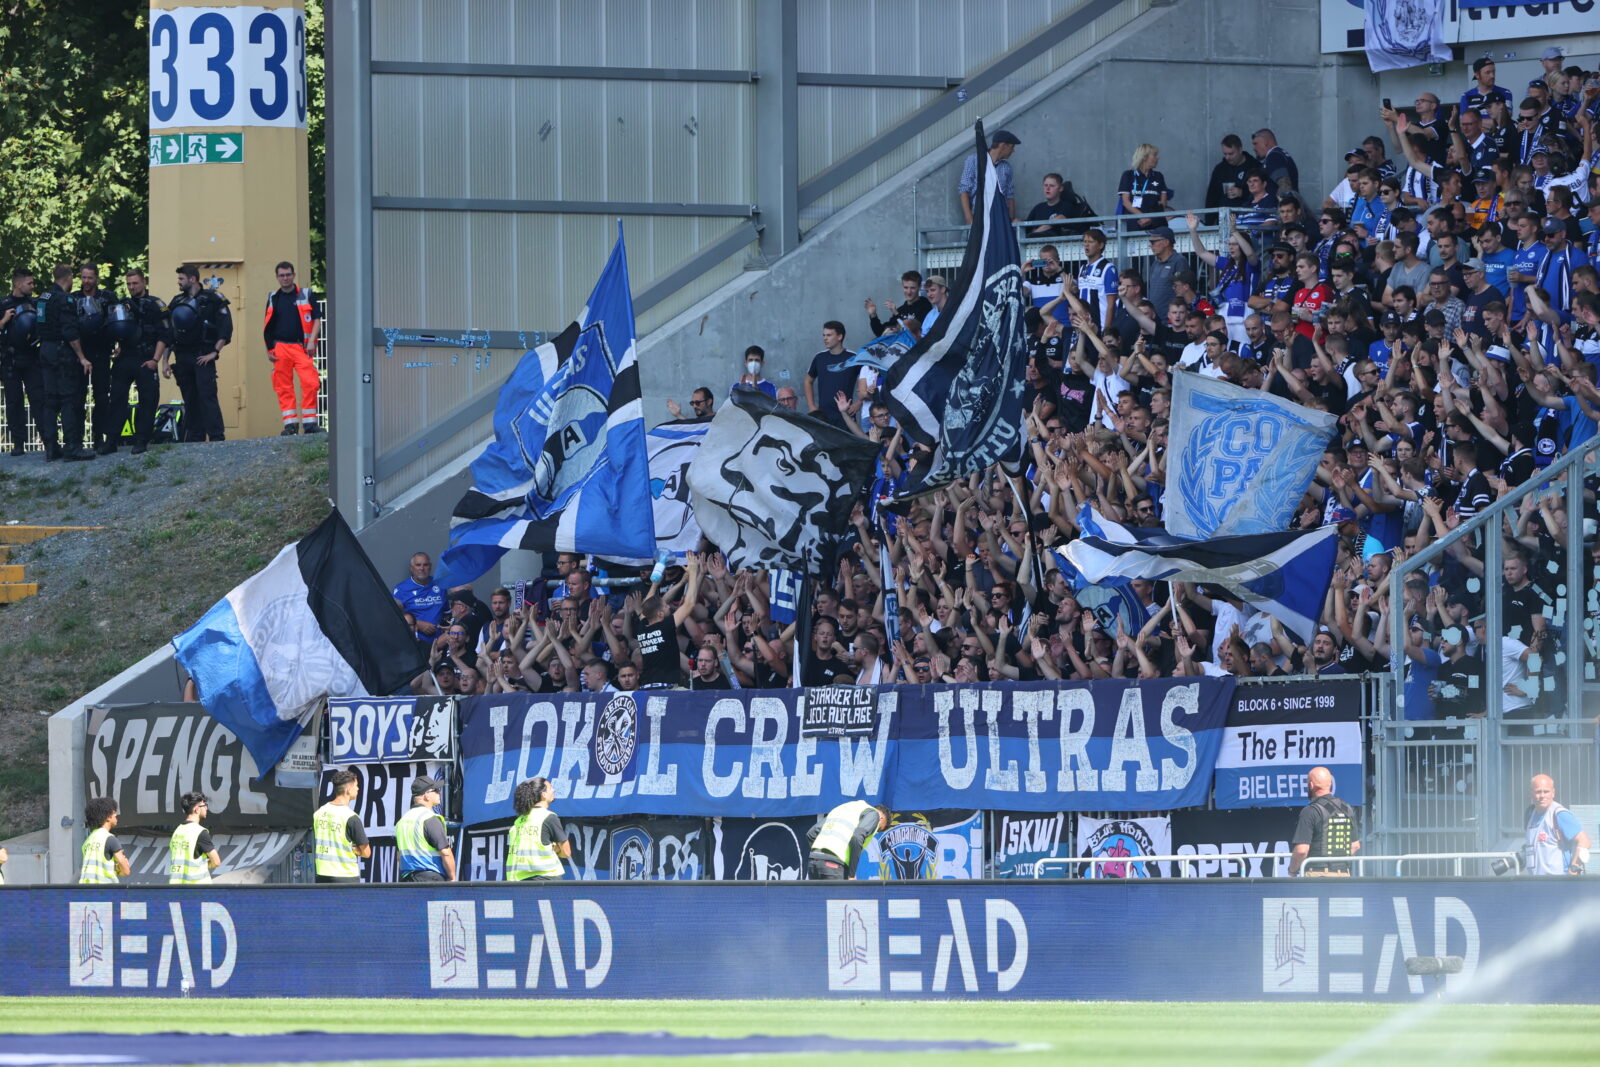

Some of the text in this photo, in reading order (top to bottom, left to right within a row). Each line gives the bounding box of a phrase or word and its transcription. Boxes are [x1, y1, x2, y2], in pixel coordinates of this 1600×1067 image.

[853, 688, 872, 705] ALS
[1238, 695, 1335, 712] BLOCK 6 SINCE 1998
[829, 706, 873, 724] AUFLAGE
[330, 704, 412, 760] BOYS
[485, 683, 1200, 804] LOKL CREW ULTRAS
[1238, 730, 1336, 761] The Firm
[1239, 774, 1336, 800] BIELEFE
[1015, 862, 1044, 876] ULTRS
